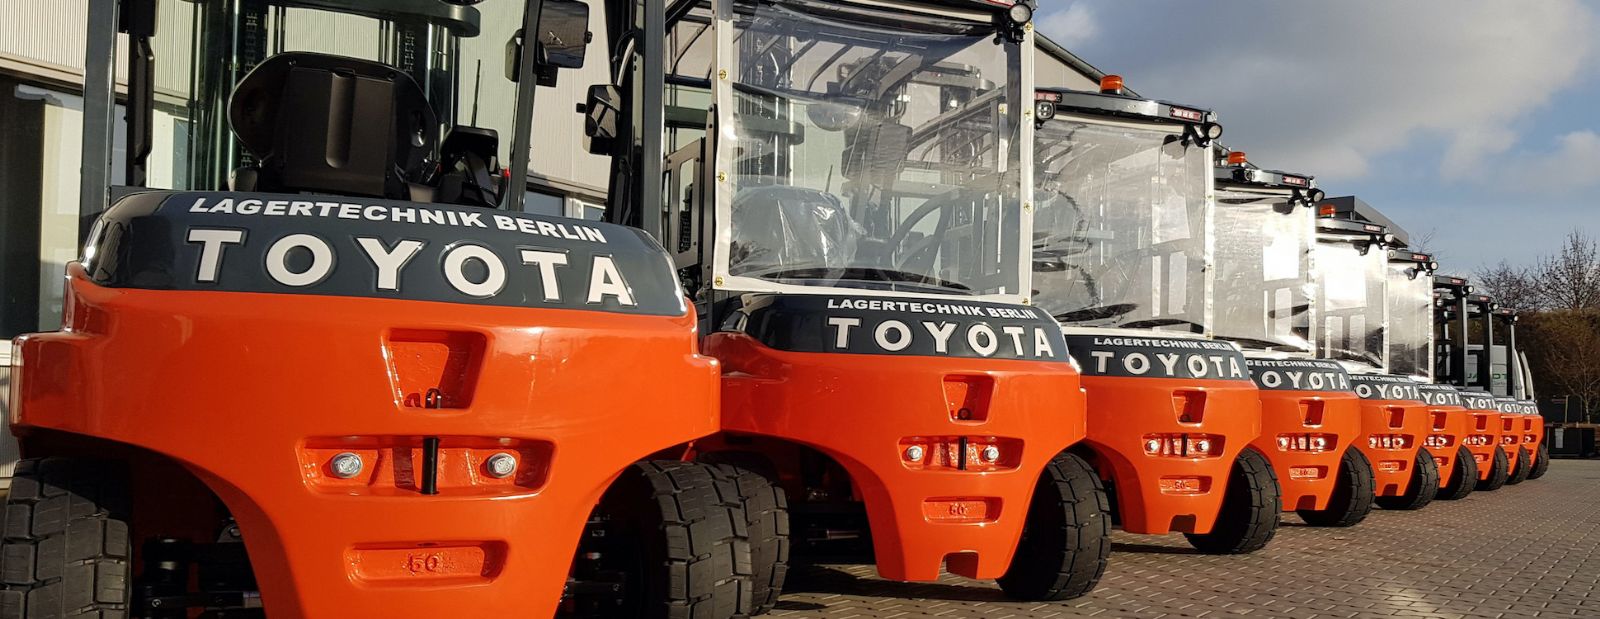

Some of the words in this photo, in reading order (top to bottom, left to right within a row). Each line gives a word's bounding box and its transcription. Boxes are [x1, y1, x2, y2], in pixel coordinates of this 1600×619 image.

[189, 198, 487, 228] LAGERTECHNIK
[494, 215, 608, 244] BERLIN
[187, 229, 638, 307] TOYOTA
[827, 299, 984, 317] LAGERTECHNIK
[986, 307, 1039, 320] BERLIN
[828, 317, 1054, 358] TOYOTA
[1094, 338, 1201, 349] LAGERTECHNIK
[1201, 341, 1235, 352] BERLIN
[1091, 351, 1243, 378] TOYOTA
[1246, 360, 1314, 368] GERTECHNIK
[1248, 370, 1349, 390] OYOTA
[1355, 384, 1420, 399] OYOTA
[1421, 391, 1461, 405] YOTA
